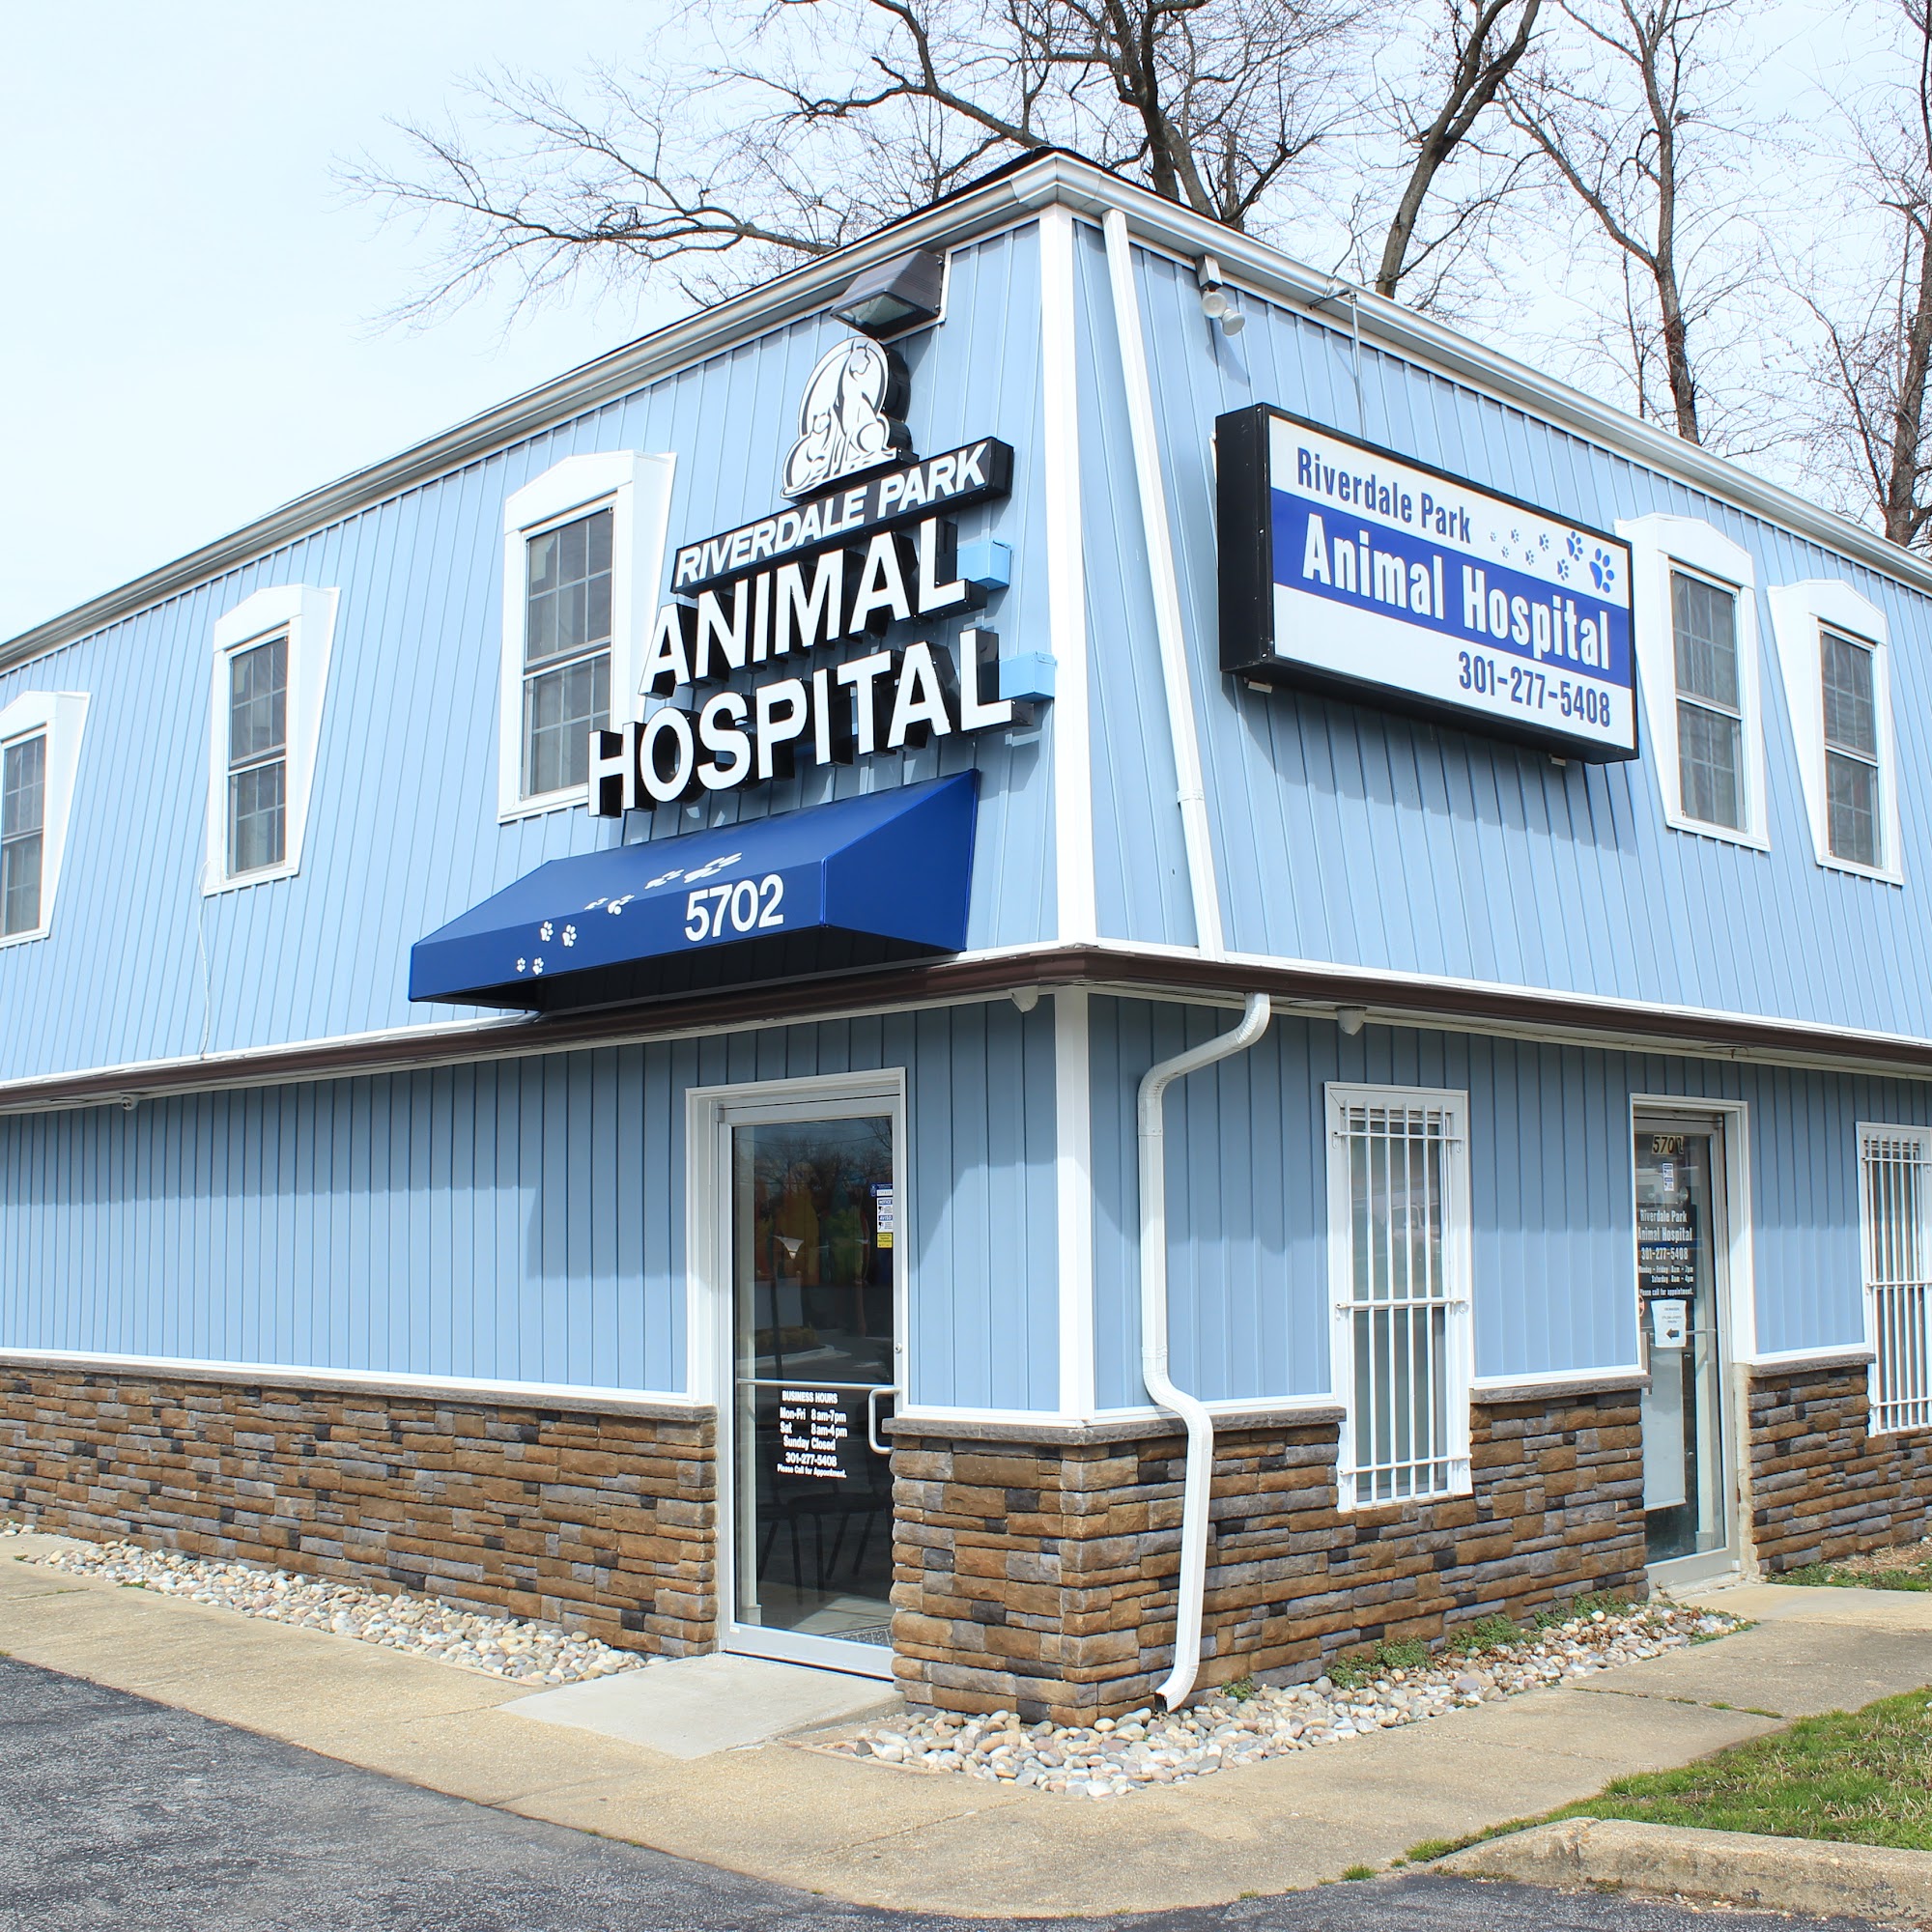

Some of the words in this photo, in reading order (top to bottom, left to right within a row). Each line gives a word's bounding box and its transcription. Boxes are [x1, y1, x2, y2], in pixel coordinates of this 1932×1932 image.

[1297, 447, 1412, 523] Riverdale
[1421, 493, 1471, 544] Park
[676, 491, 866, 586] RIVERDALE
[877, 441, 988, 520] PARK
[1302, 513, 1445, 620] Animal
[1462, 564, 1609, 670] Hospital
[639, 517, 966, 696] ANIMAL
[1459, 651, 1610, 727] 301-277-5408
[587, 629, 1012, 817] HOSPITAL
[685, 873, 784, 942] 5702
[1639, 1209, 1670, 1222] Riverdale
[1671, 1210, 1687, 1223] Park
[1638, 1227, 1660, 1241] Animal
[1662, 1227, 1692, 1243] Hospital
[1641, 1247, 1689, 1260] 301-277-5408
[781, 1390, 814, 1403] BUSINESS
[814, 1392, 838, 1405] HOURS
[780, 1406, 806, 1421] Mon-Fri
[780, 1421, 792, 1435] Sat
[783, 1435, 810, 1451] Sunday
[810, 1436, 837, 1451] Closed
[785, 1452, 838, 1467] 301-277-5408
[777, 1463, 793, 1474] Please
[794, 1464, 804, 1475] Call
[813, 1466, 847, 1479] Appointment.
